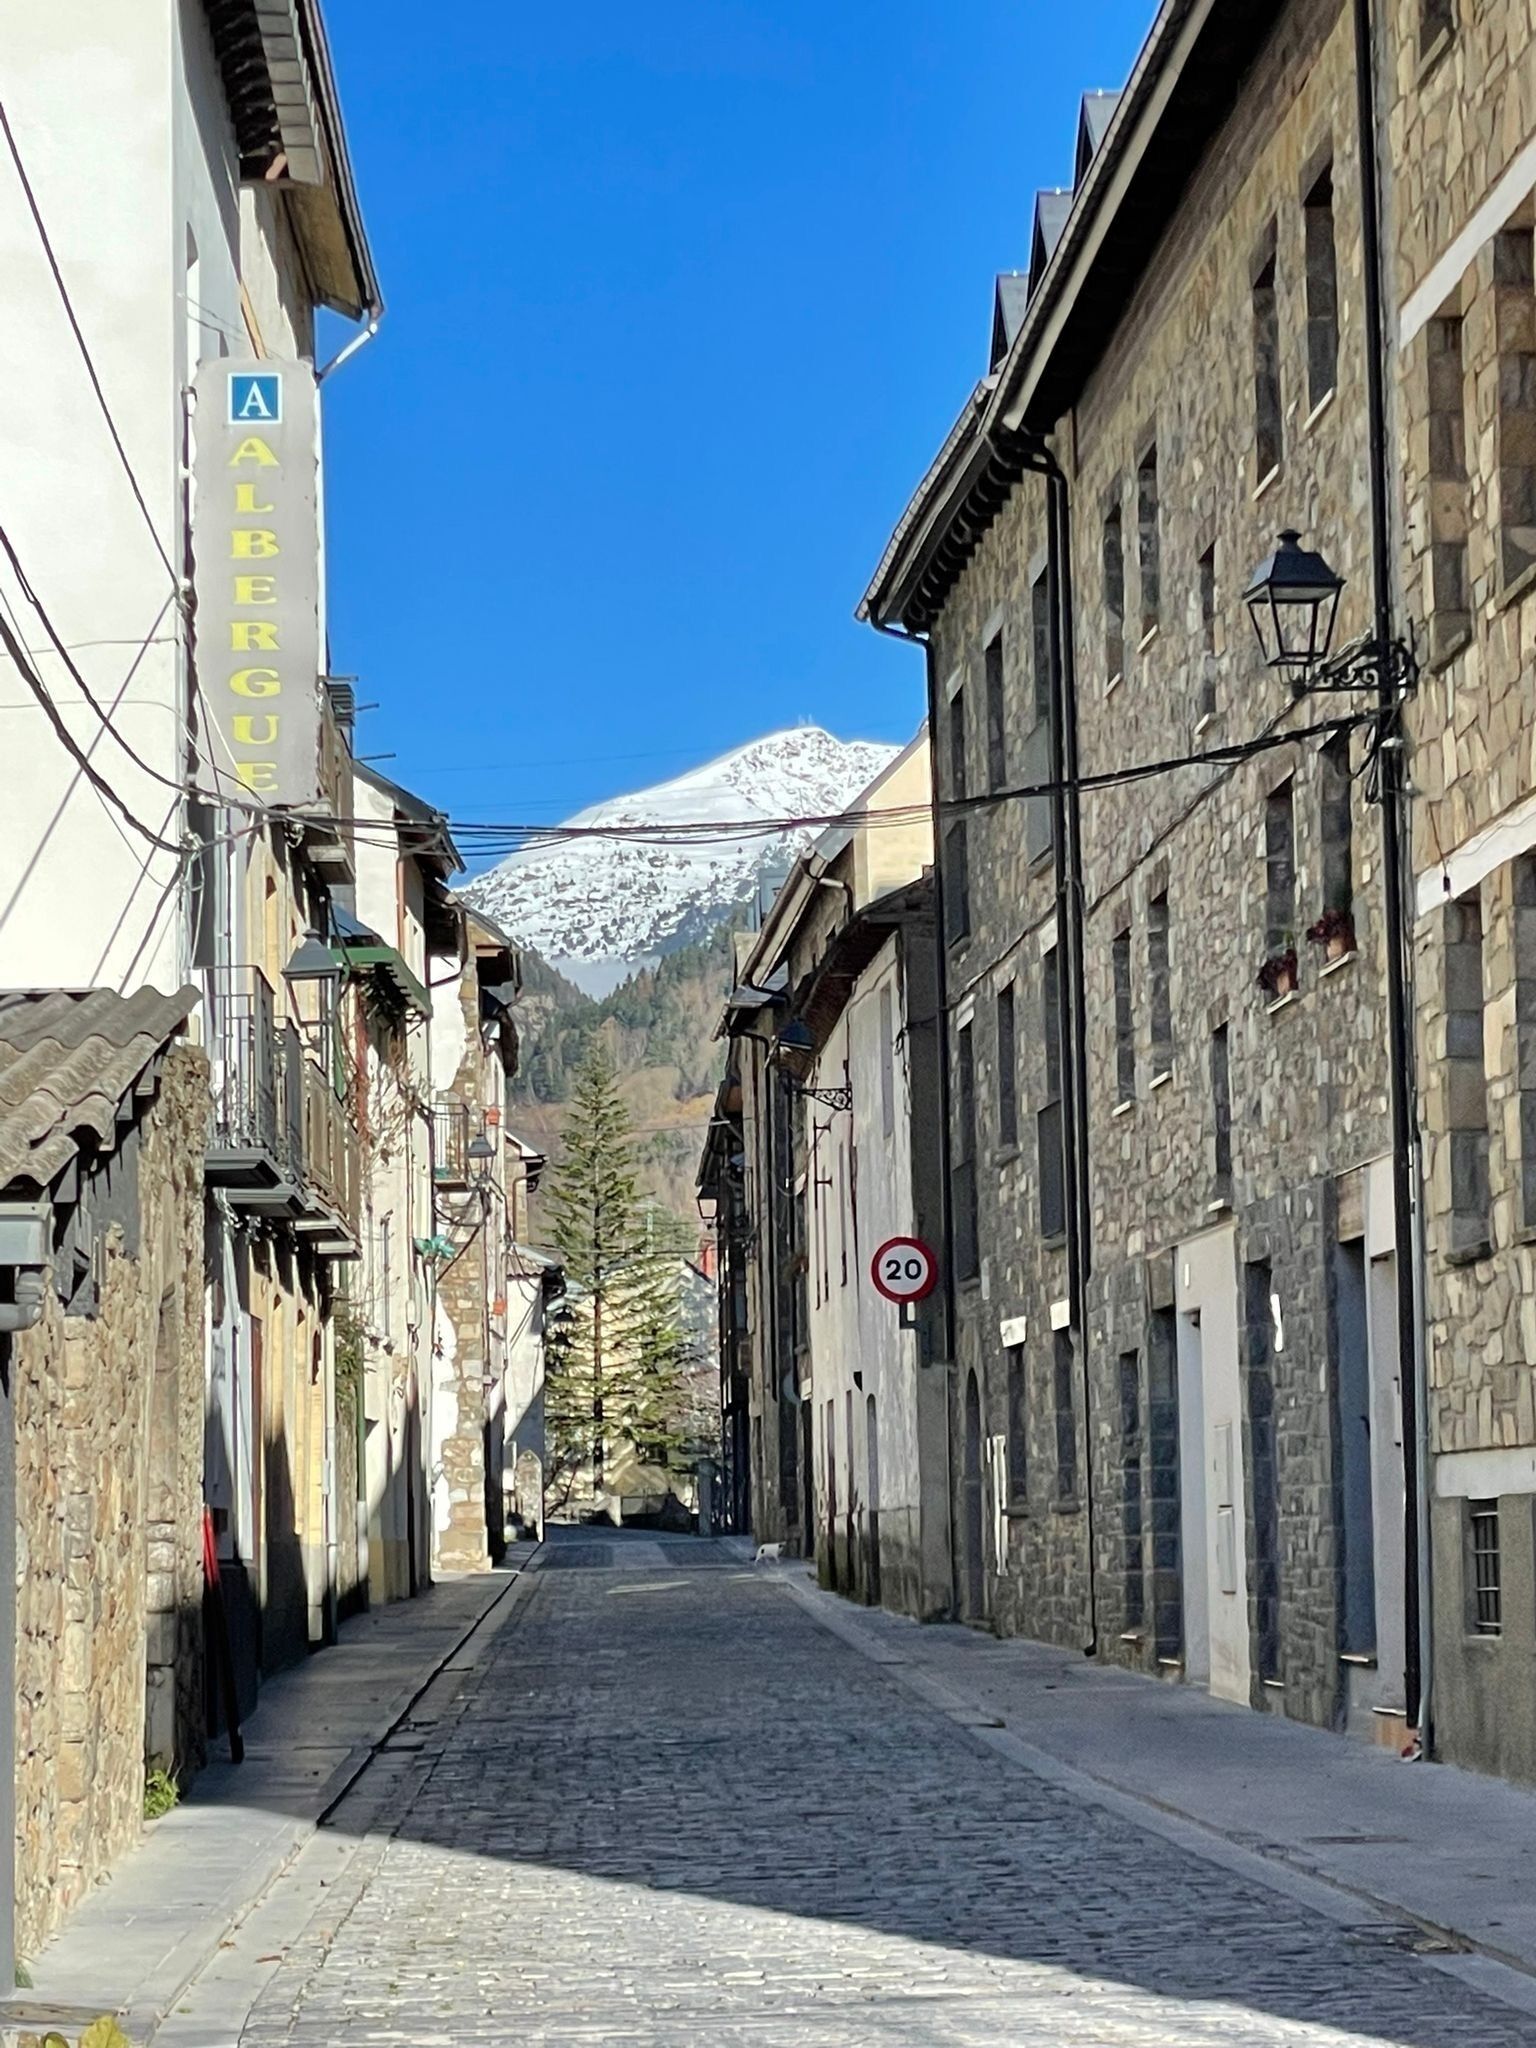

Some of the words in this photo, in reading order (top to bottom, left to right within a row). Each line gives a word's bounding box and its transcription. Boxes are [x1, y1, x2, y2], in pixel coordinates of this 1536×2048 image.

[238, 380, 273, 418] A
[228, 437, 282, 792] ALBERGUE
[886, 1258, 922, 1280] 20
